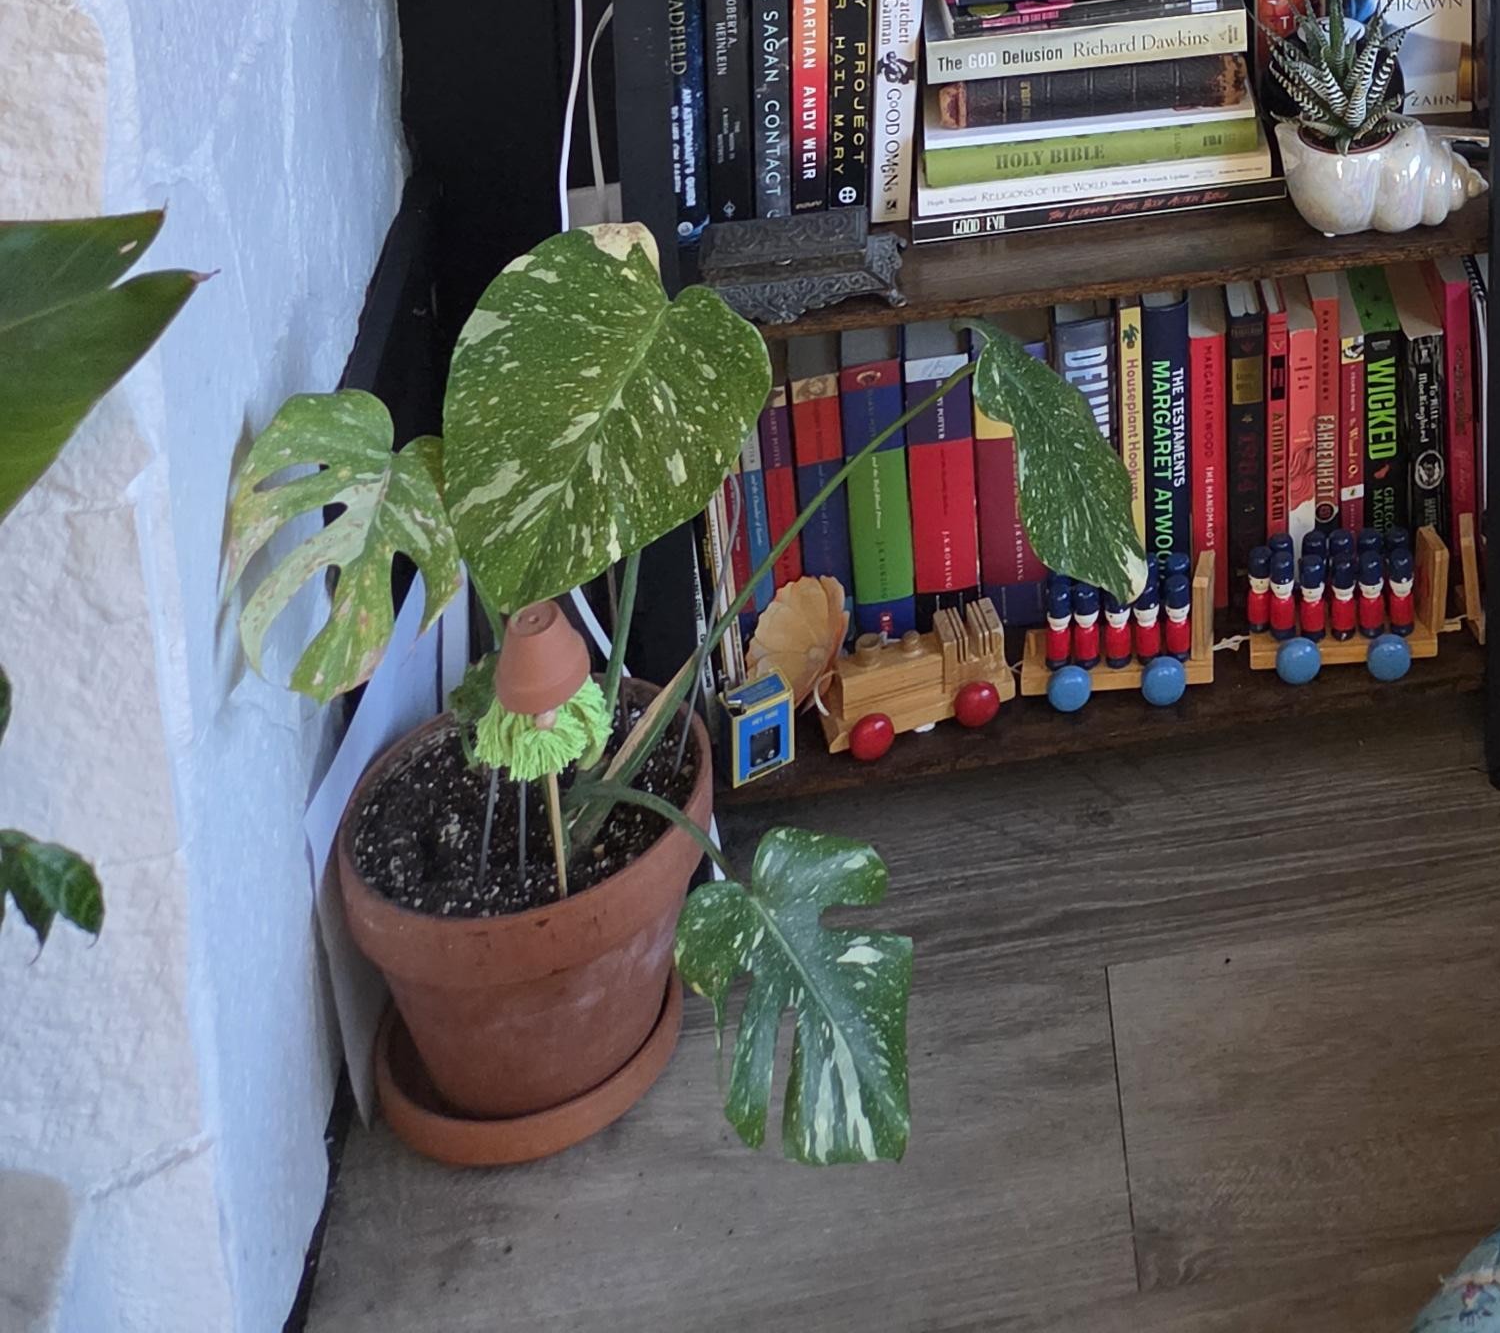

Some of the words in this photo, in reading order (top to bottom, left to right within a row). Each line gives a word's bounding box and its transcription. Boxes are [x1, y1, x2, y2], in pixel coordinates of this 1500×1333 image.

[762, 10, 780, 83] SAGAN
[834, 36, 847, 98] HAIL
[937, 57, 963, 72] The
[968, 52, 997, 68] GOD
[1002, 47, 1063, 65] Delusion
[1072, 38, 1137, 59] Richard
[1141, 31, 1210, 51] Dawkins
[803, 86, 816, 133] ANDY
[853, 42, 866, 164] PROJECT
[764, 100, 782, 197] CONTACT
[803, 138, 816, 180] WEIR
[833, 114, 844, 175] MARY
[995, 150, 1045, 170] HOLY
[1050, 144, 1105, 165] BIBLE
[1126, 359, 1139, 428] Houseplant
[1171, 367, 1183, 390] THE
[1367, 356, 1398, 461] WICKED
[1415, 373, 1429, 443] Mockingbird
[1151, 359, 1173, 479] MARGARET
[1171, 396, 1185, 487] TESTAMENTS
[1316, 414, 1335, 500] FAHRENHEIT
